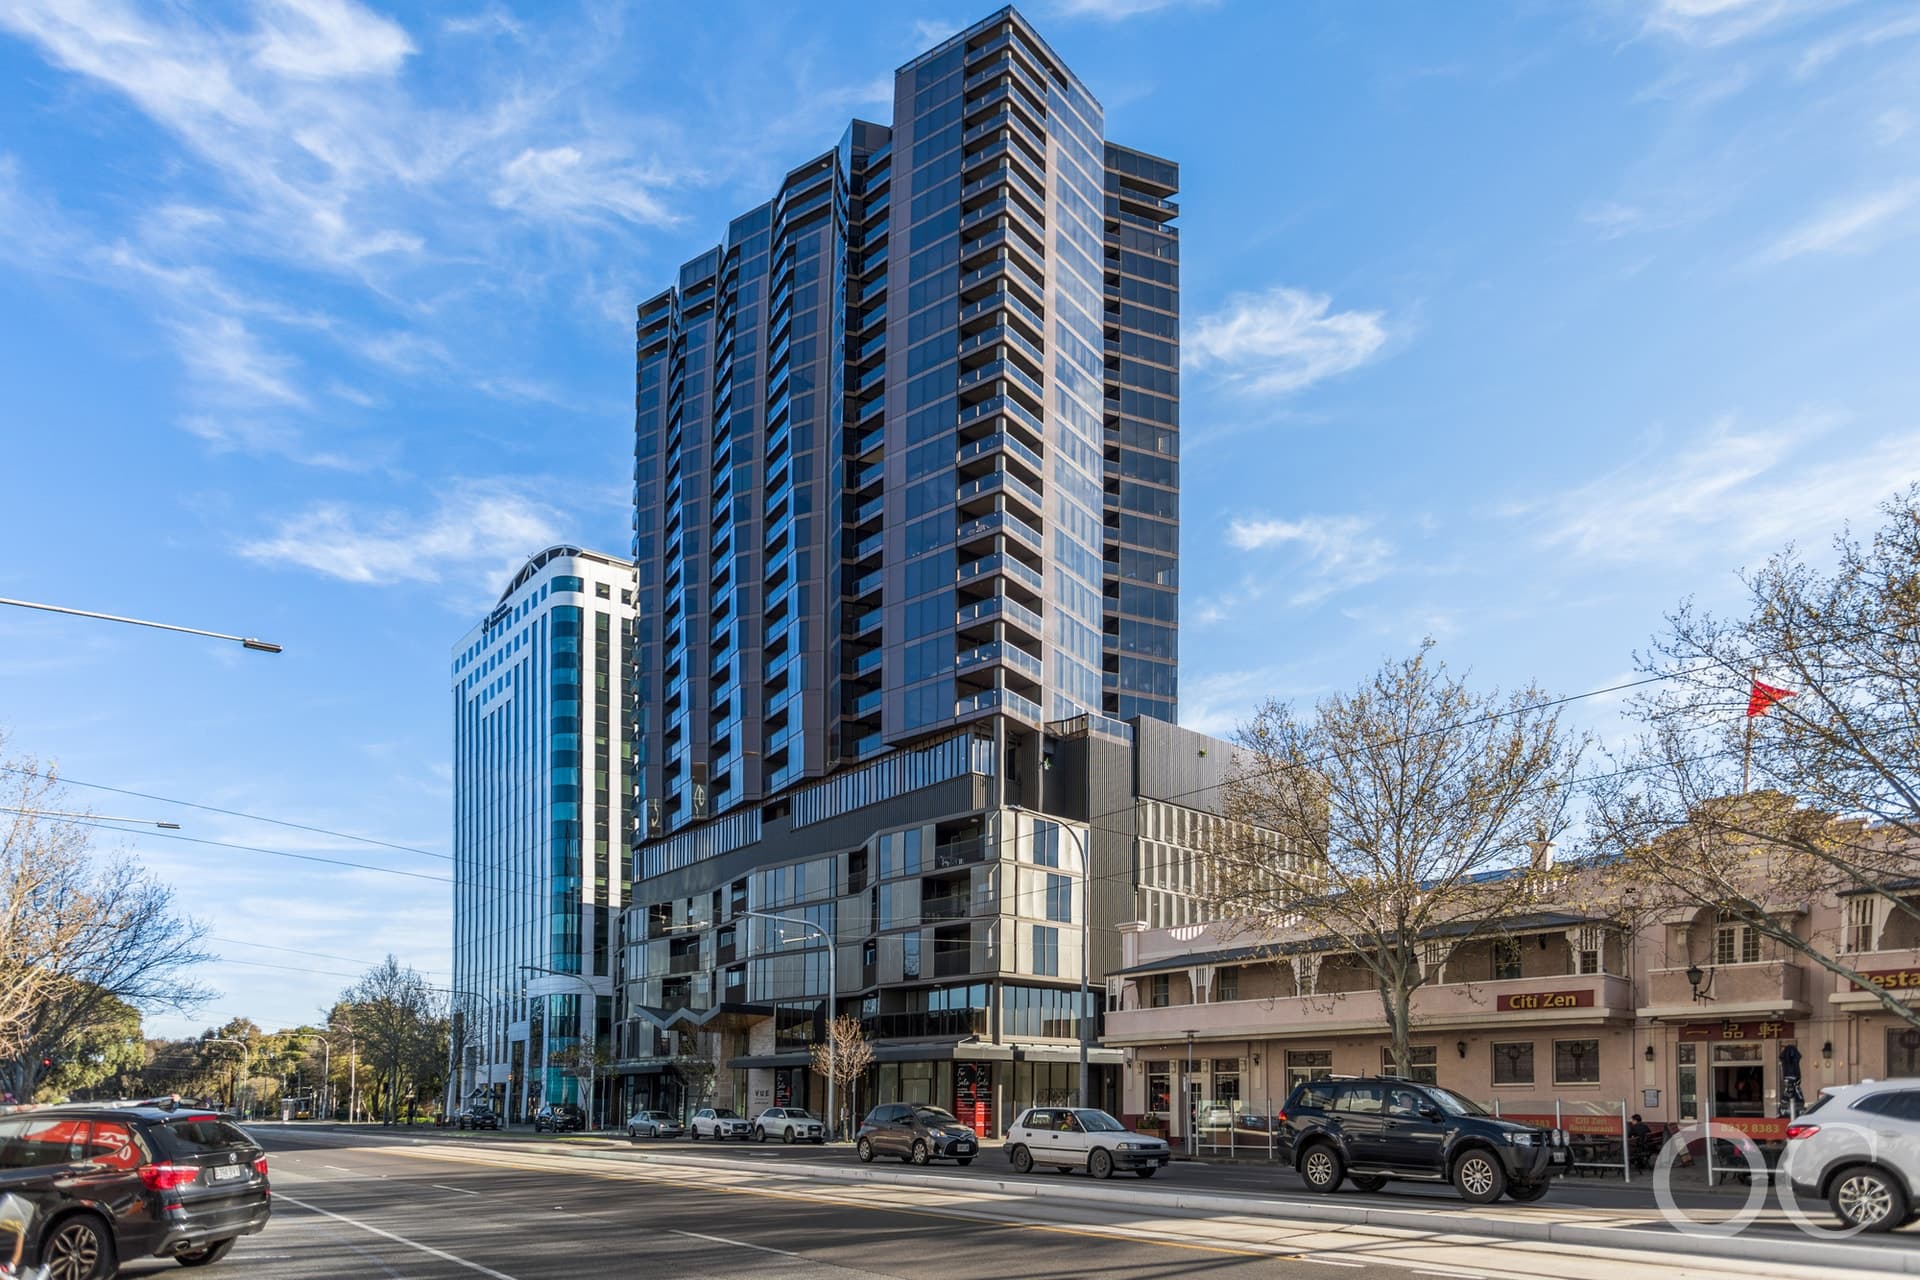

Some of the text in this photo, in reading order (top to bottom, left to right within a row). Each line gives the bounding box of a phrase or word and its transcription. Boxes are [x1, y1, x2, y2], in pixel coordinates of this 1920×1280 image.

[1509, 993, 1577, 1009] Citi Zen
[754, 1089, 770, 1097] VUE
